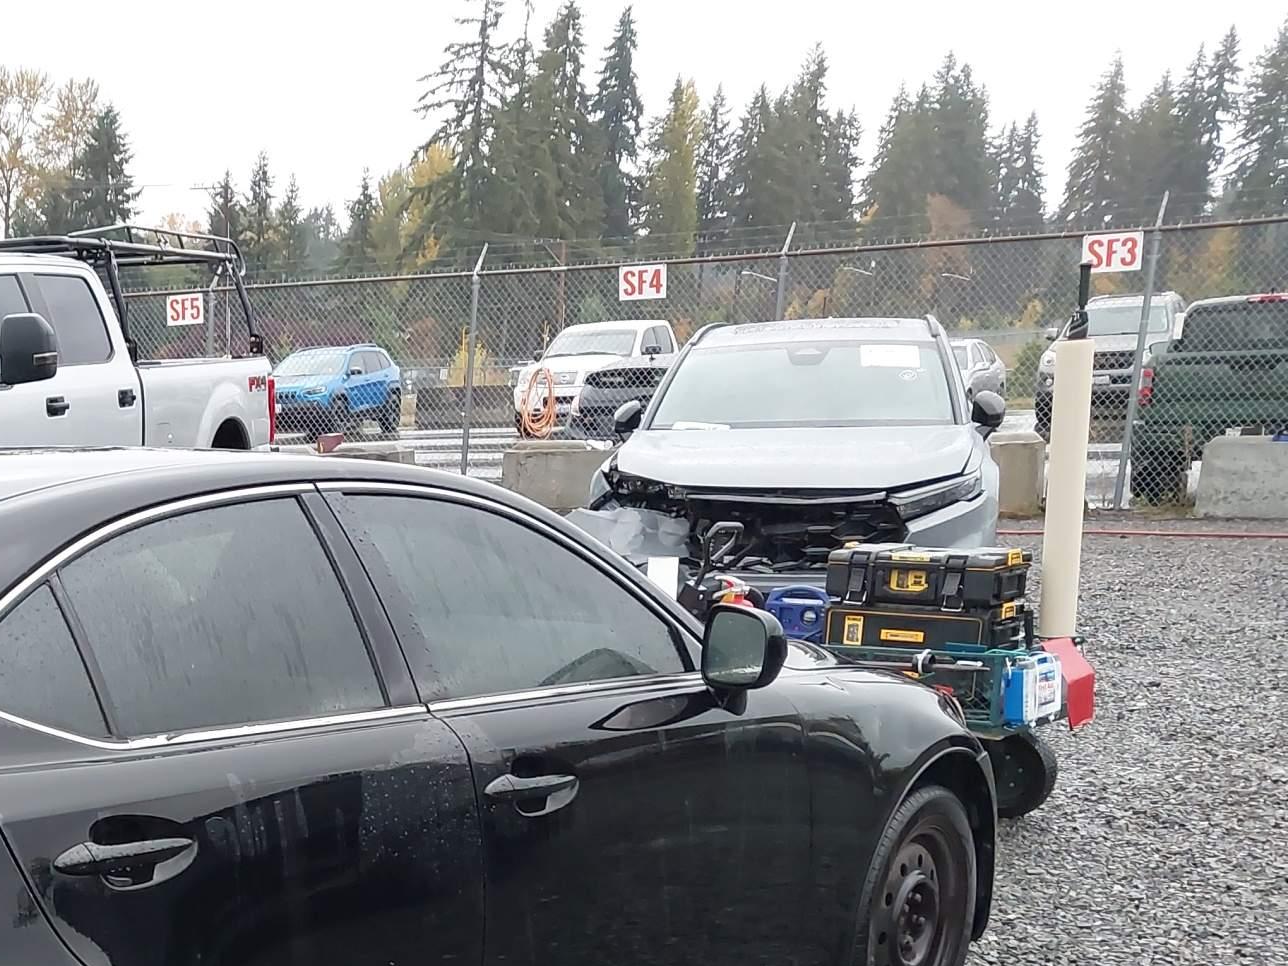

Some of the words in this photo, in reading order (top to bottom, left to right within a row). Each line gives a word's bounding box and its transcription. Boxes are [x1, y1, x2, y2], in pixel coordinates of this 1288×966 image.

[1087, 237, 1139, 269] SF3
[623, 269, 663, 297] SF4
[169, 297, 201, 322] SF5
